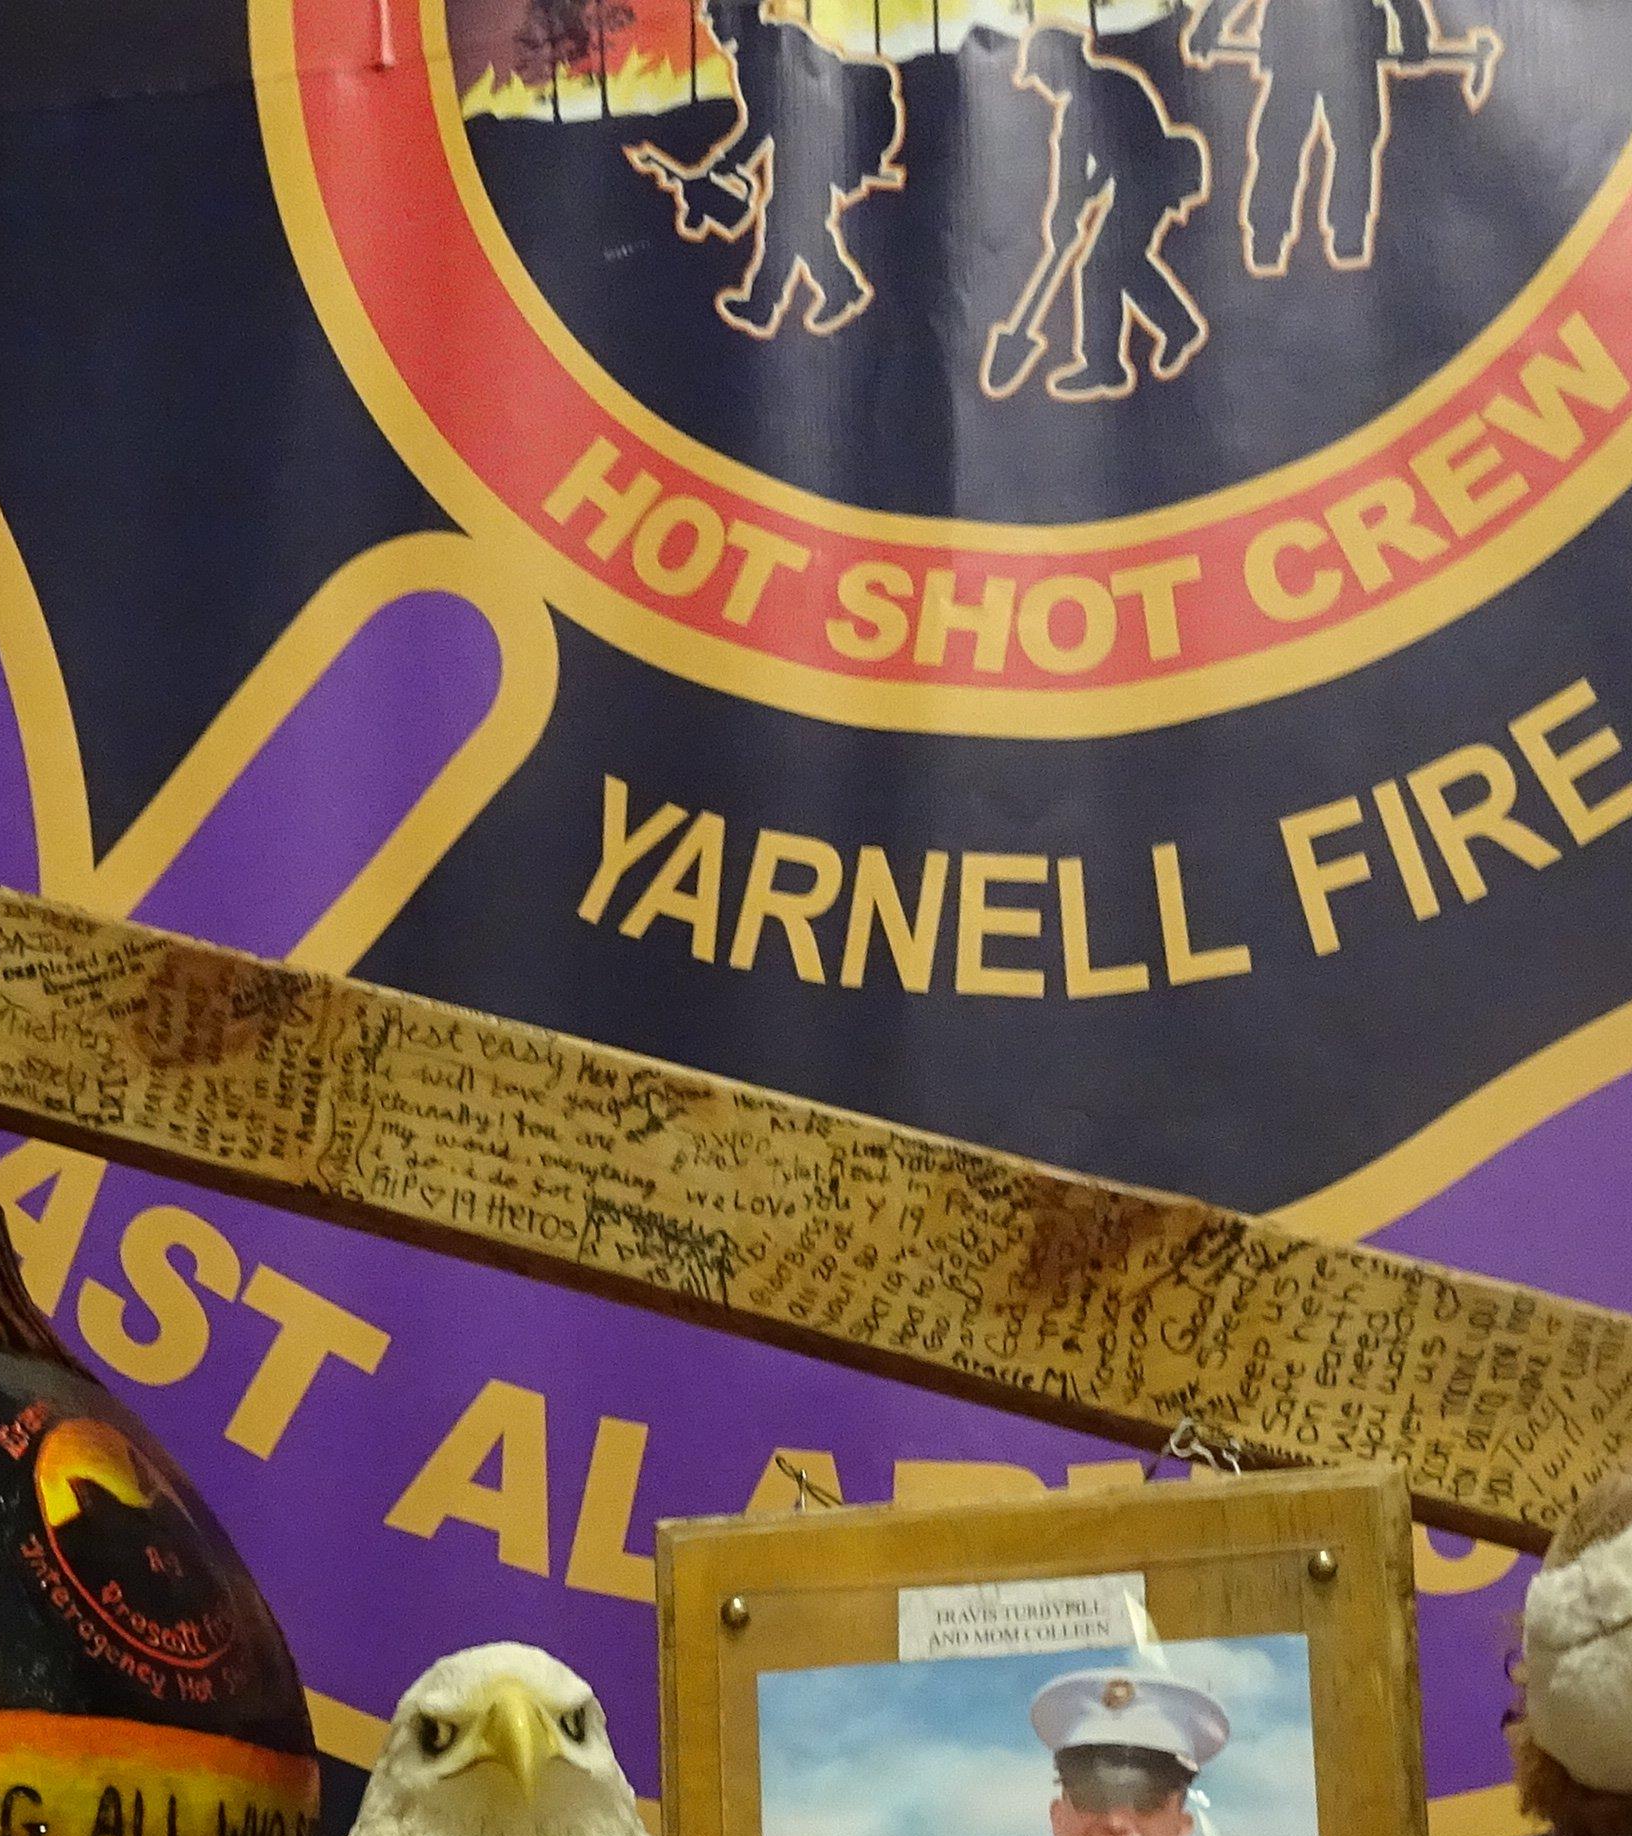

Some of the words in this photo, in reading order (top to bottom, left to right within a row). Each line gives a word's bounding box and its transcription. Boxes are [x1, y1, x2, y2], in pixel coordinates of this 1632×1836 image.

[542, 433, 814, 627] HOT
[826, 553, 1200, 675] SHOT
[577, 775, 1252, 1000] YARNELL
